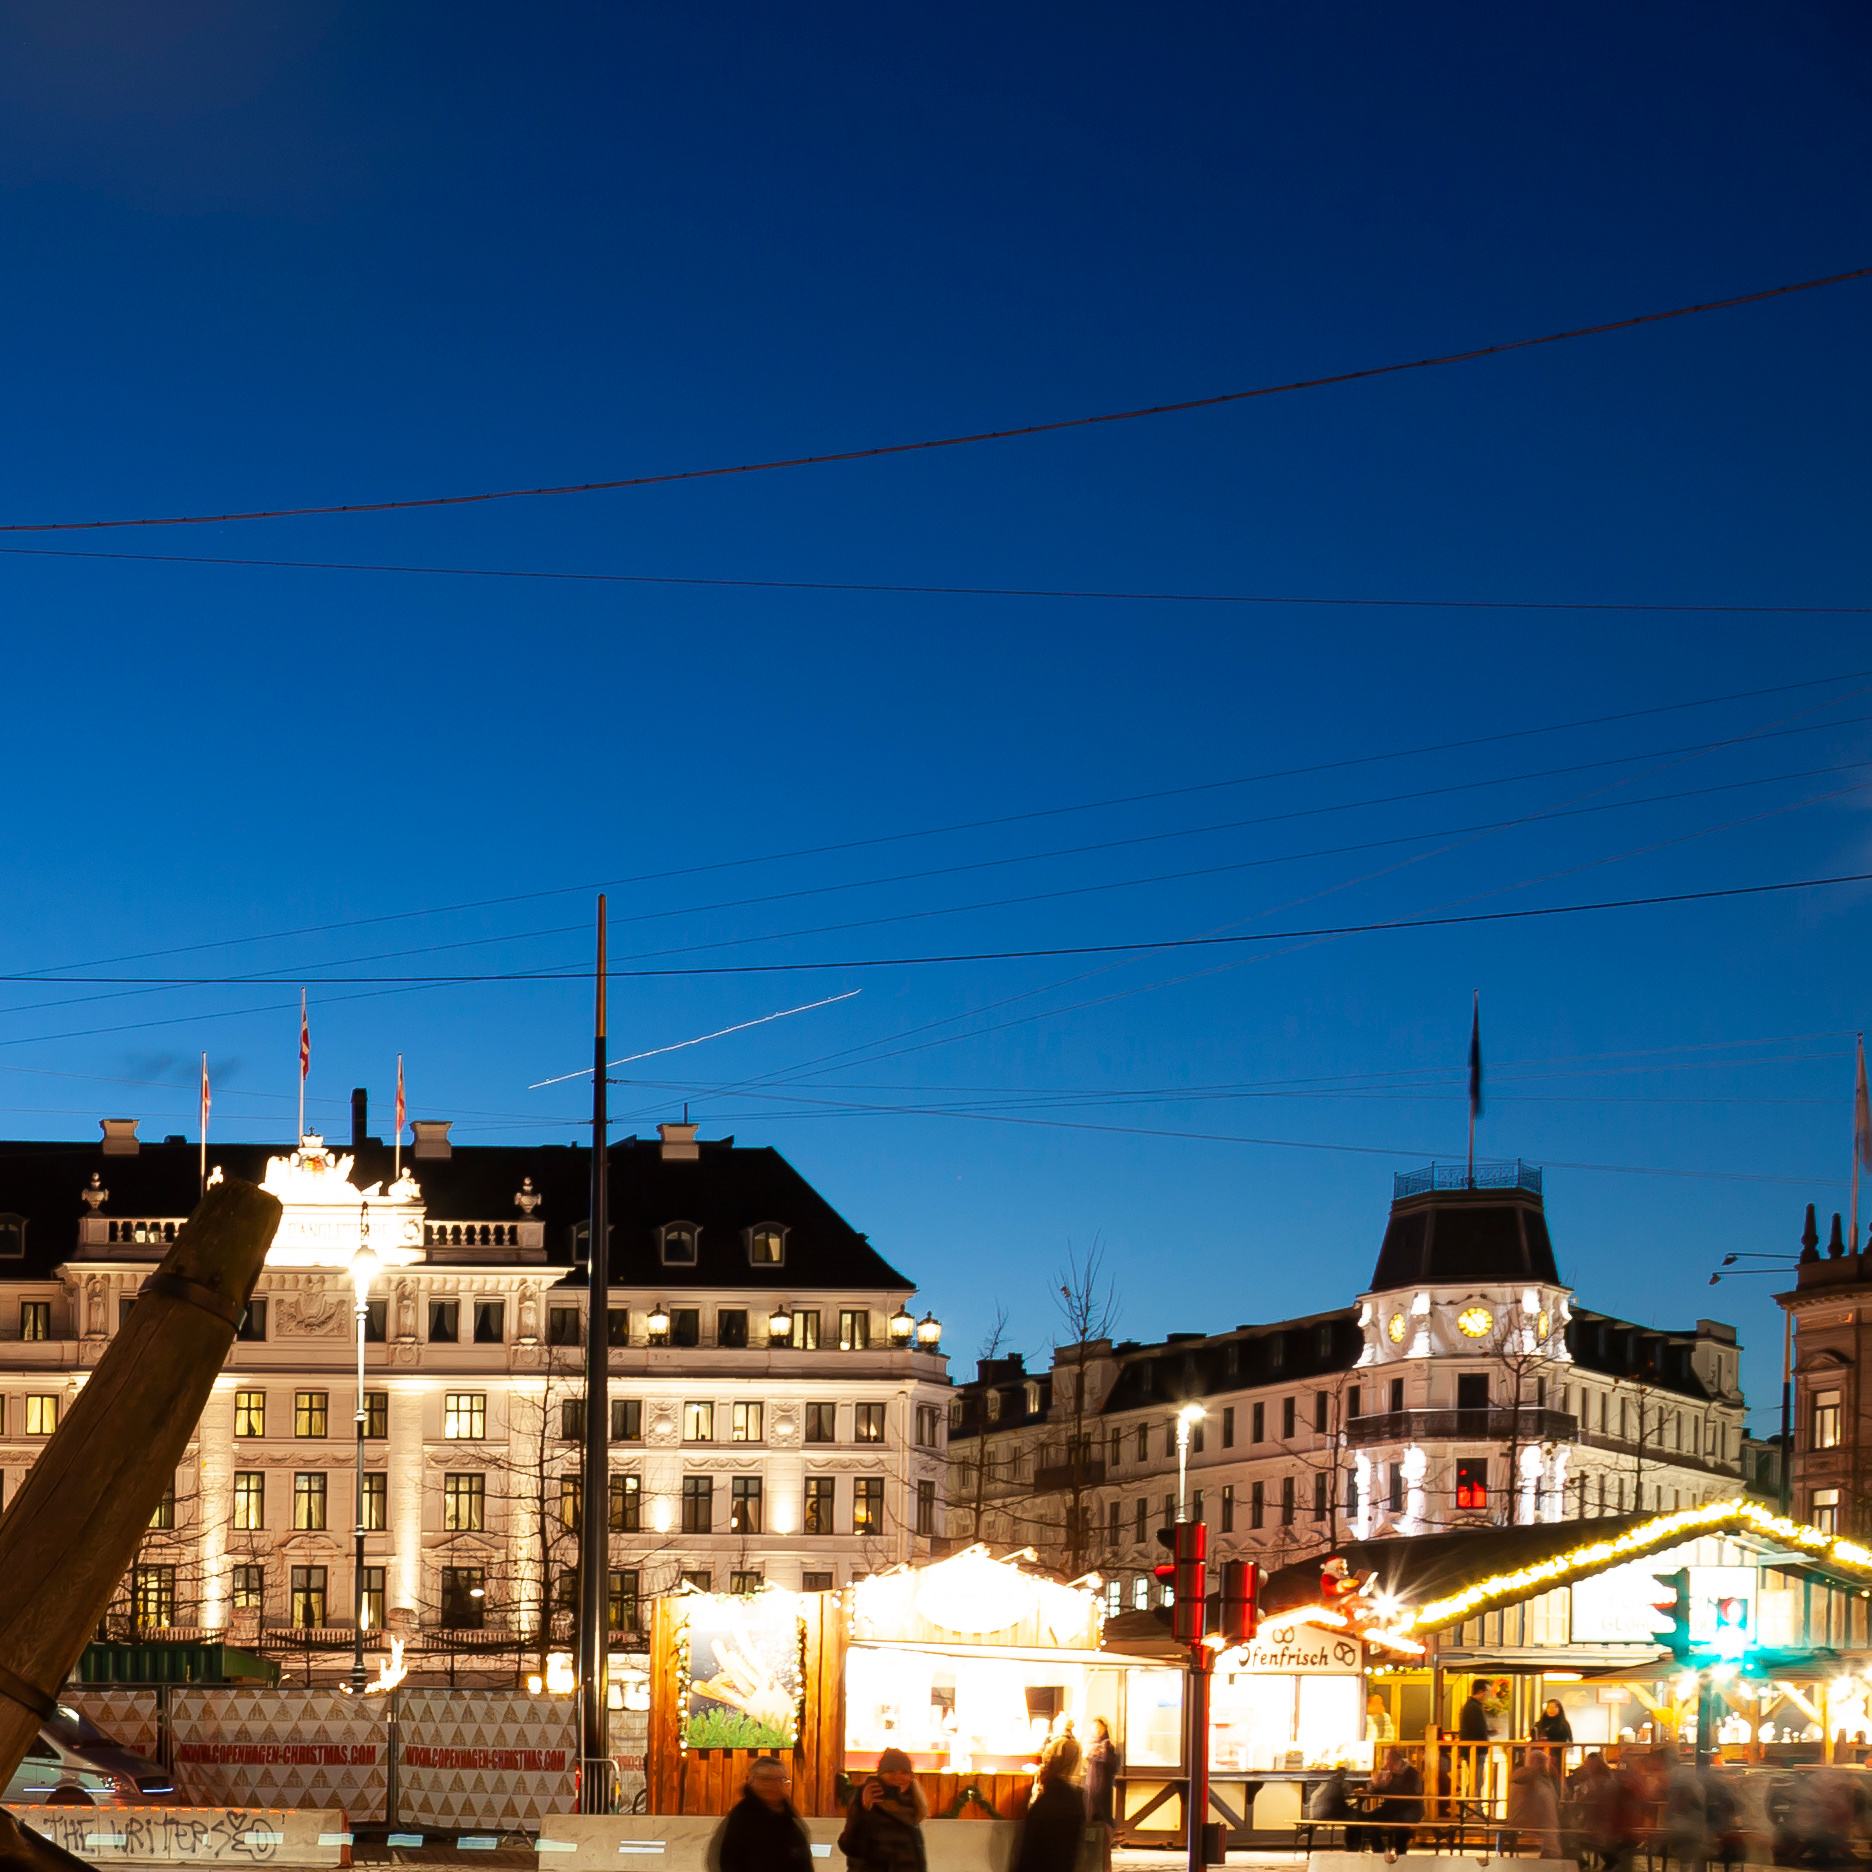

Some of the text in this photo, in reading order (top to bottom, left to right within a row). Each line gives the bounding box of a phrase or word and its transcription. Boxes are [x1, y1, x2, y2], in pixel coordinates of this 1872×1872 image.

[288, 1221, 391, 1240] D'ANGLETERE
[181, 1744, 376, 1765] WWW.COPENHAGEN-CHRISTMAS.COM
[406, 1745, 566, 1771] WWW.COPENHAGEN-CHRISTMAS.COM
[43, 1815, 96, 1853] THE
